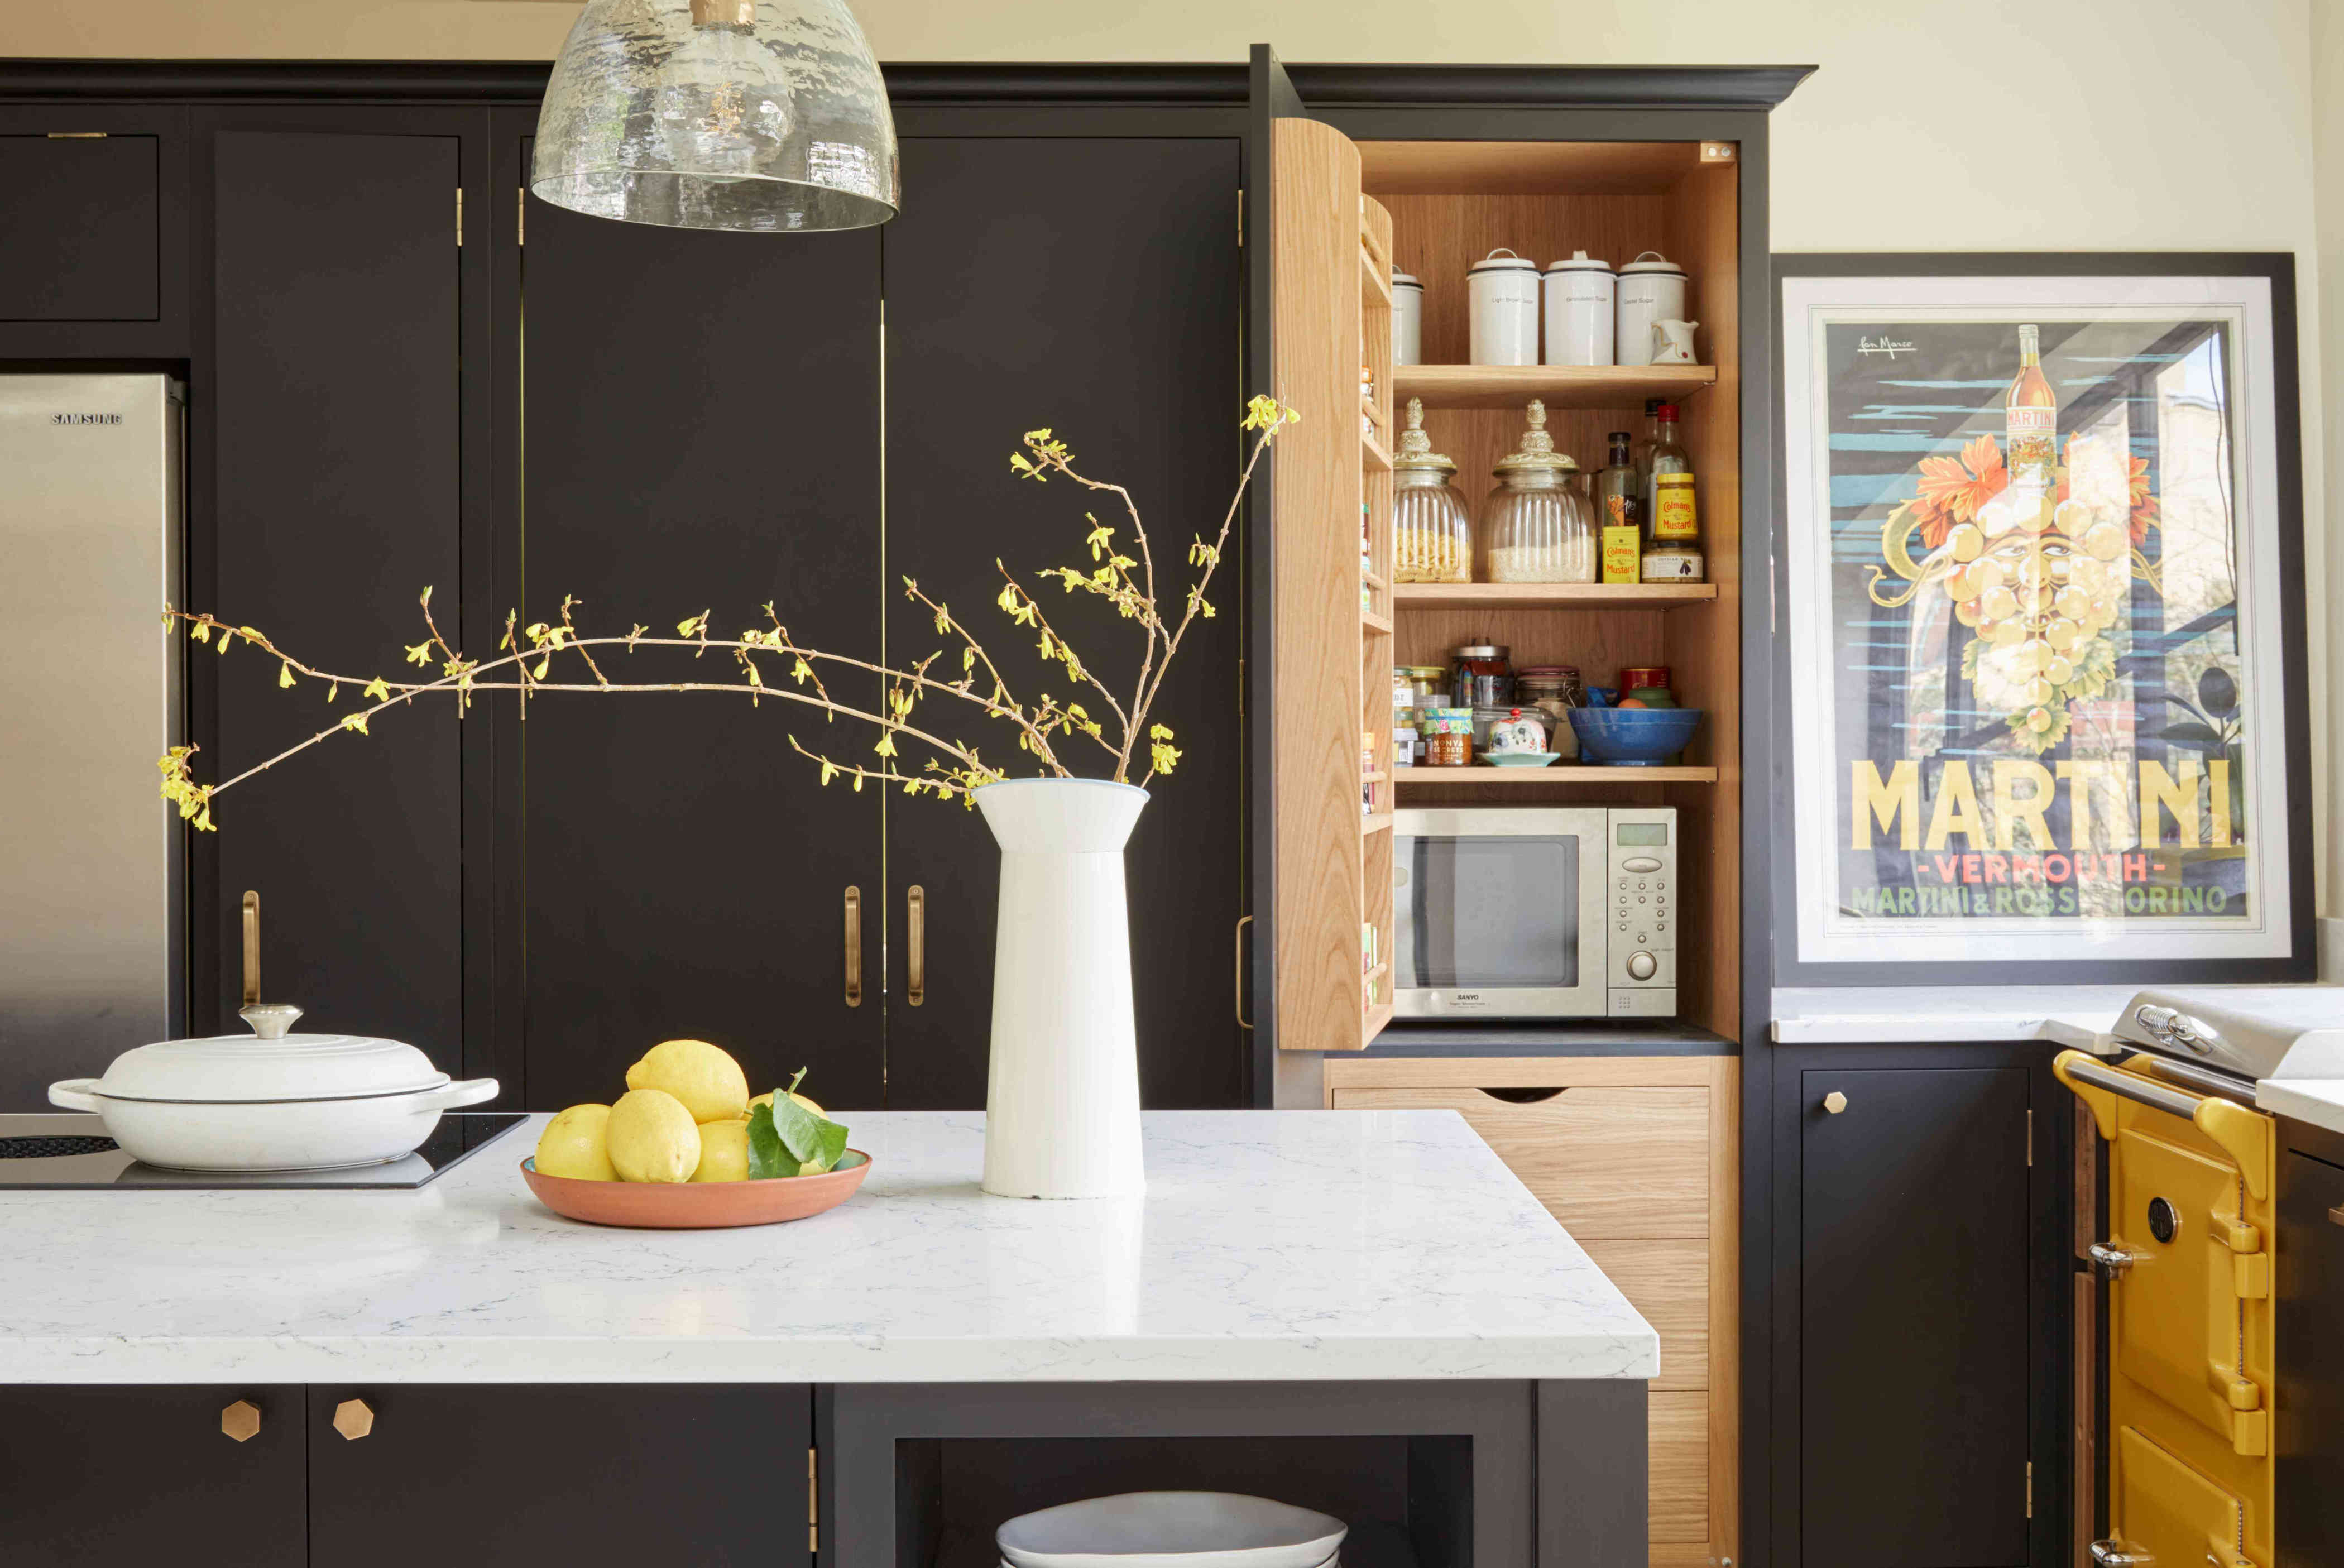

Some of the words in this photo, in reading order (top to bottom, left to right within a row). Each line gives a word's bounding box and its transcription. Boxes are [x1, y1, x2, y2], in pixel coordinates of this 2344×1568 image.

[50, 413, 122, 425] SAMSUNG
[1662, 519, 1693, 530] Mustard
[1606, 562, 1636, 574] Mustard
[1851, 760, 2232, 851] MARTINI
[1852, 886, 1969, 914] MARTINI
[1973, 893, 1991, 915] &
[1995, 886, 2087, 915] ROSS
